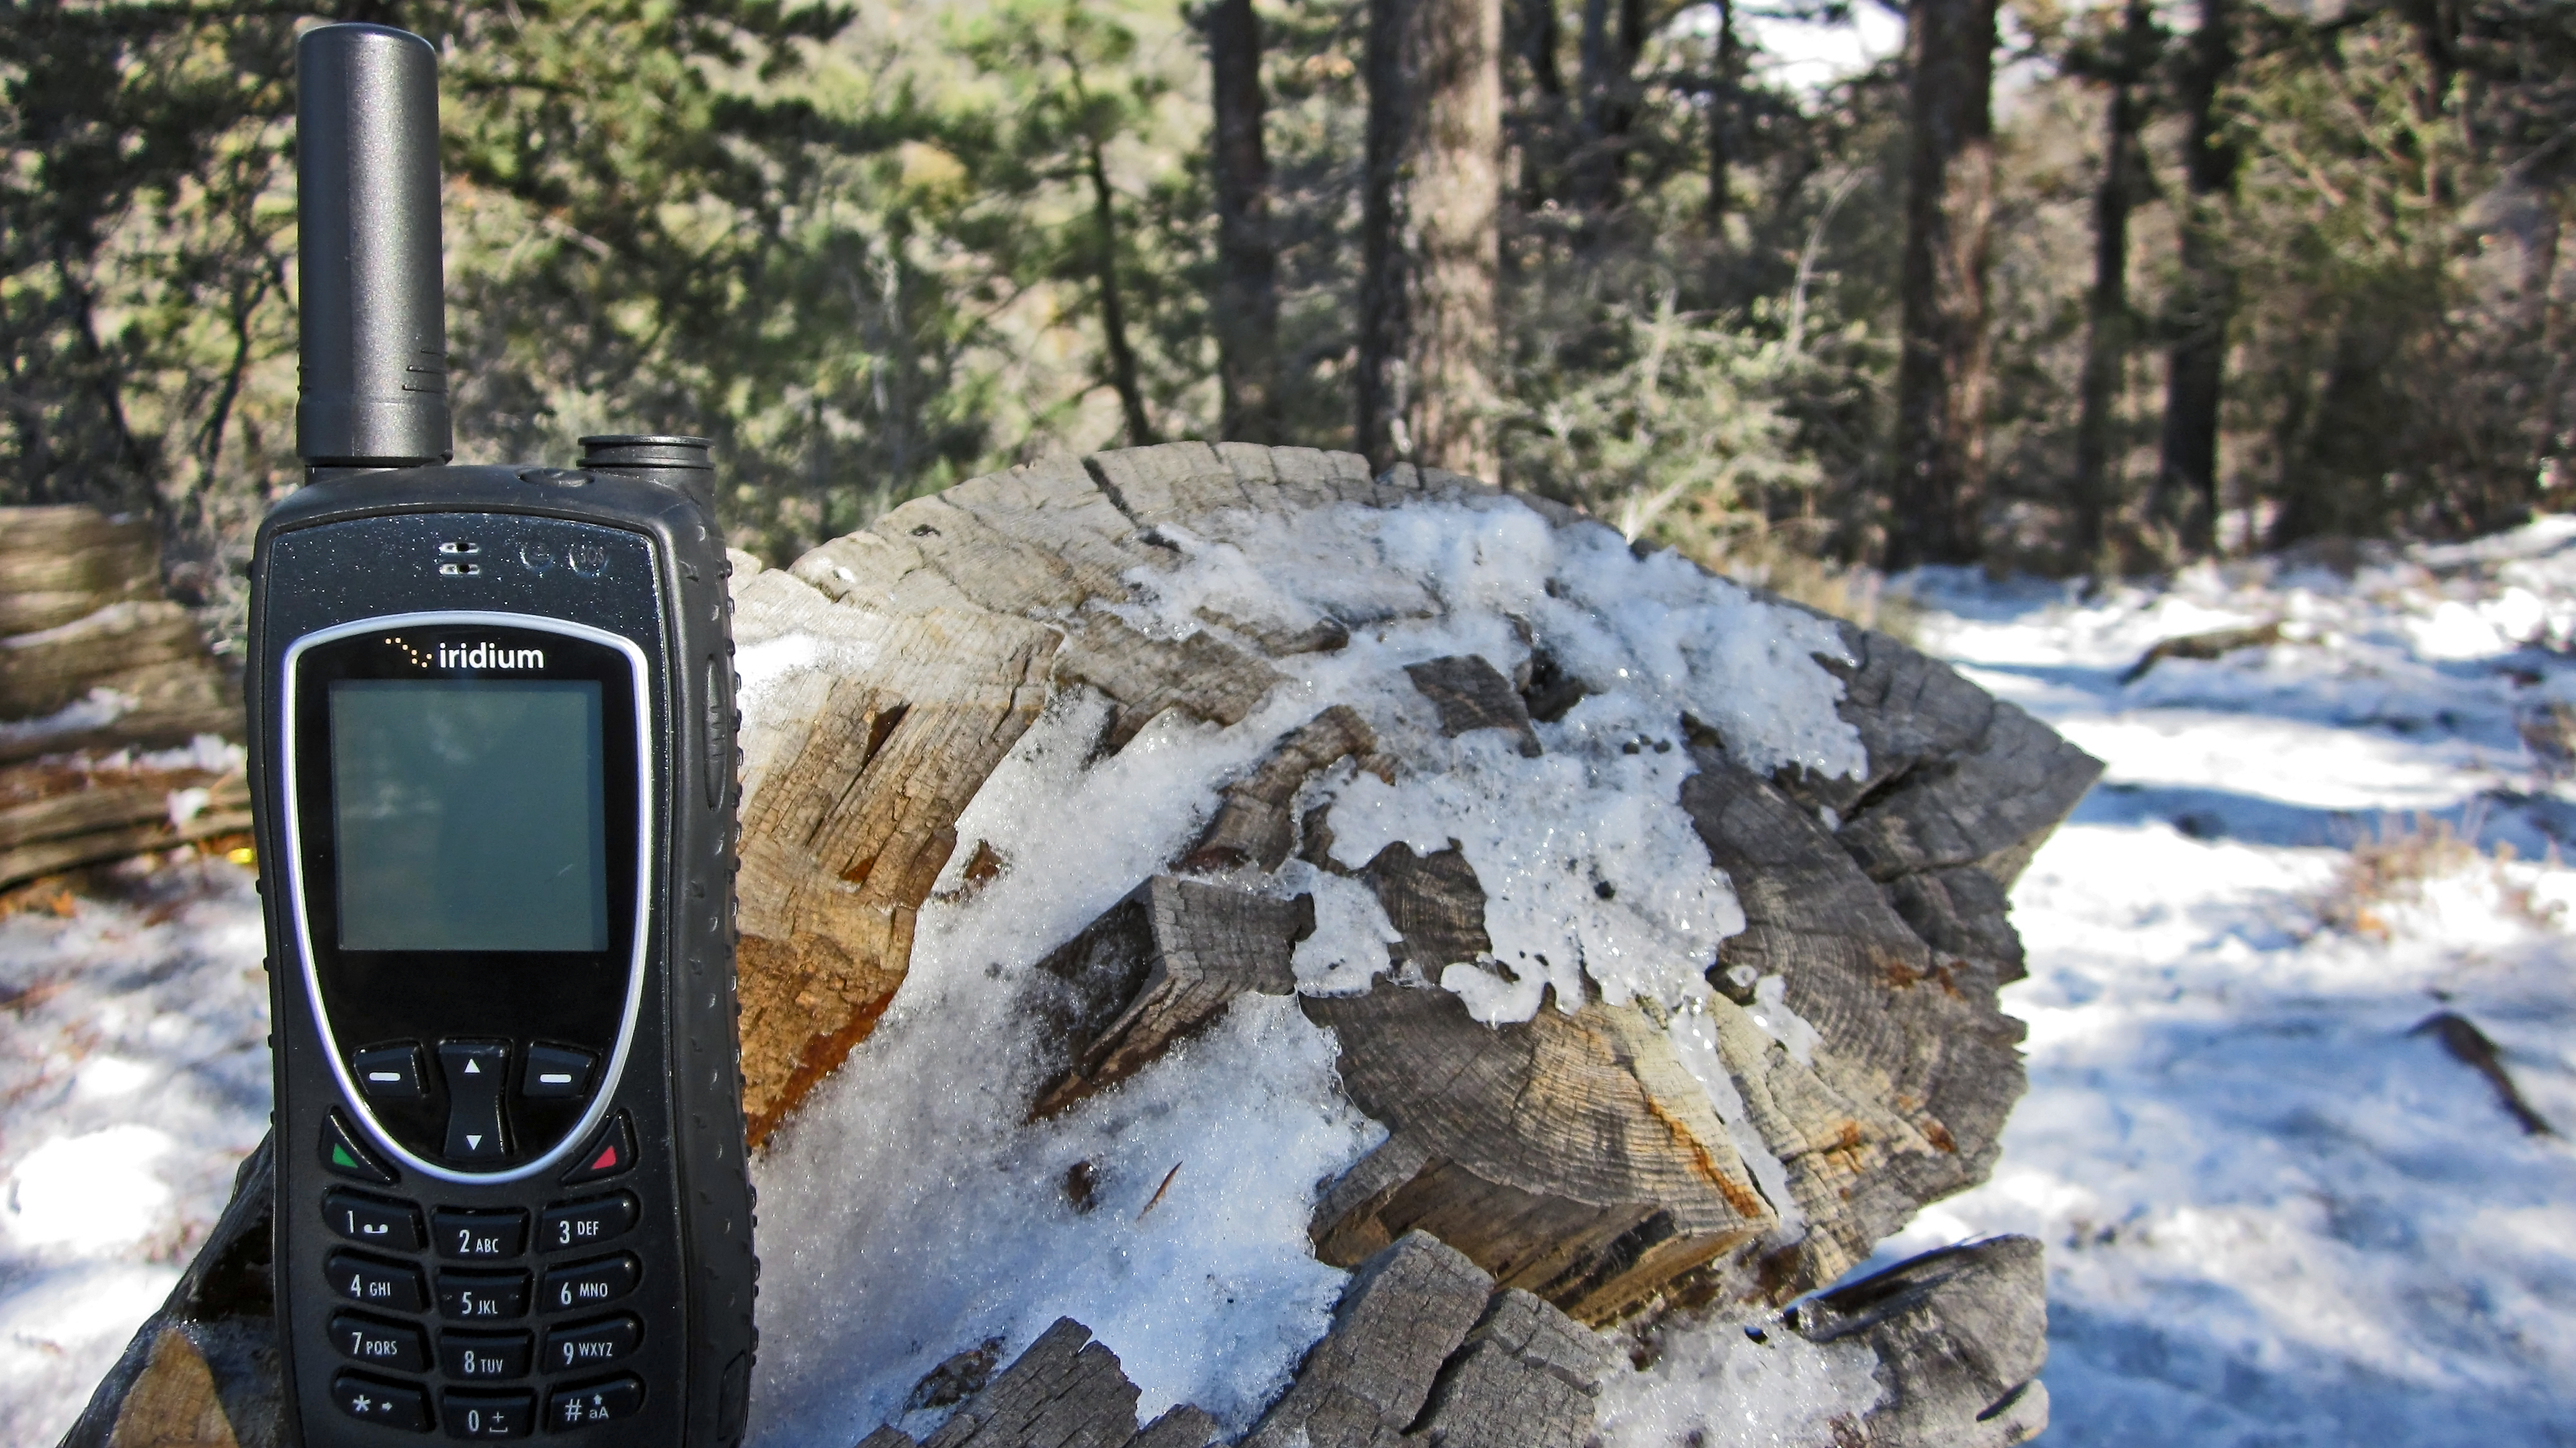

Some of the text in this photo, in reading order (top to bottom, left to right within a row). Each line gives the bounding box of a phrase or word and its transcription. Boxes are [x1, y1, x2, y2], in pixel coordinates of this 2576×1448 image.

[439, 642, 544, 669] iridium
[347, 1210, 354, 1234] 1
[559, 1220, 599, 1244] 3 DEF
[459, 1229, 499, 1253] 2 ABC
[350, 1274, 391, 1297] 4 GHI
[560, 1282, 608, 1305] 6 MNO
[462, 1291, 498, 1315] 5 JKL
[352, 1331, 397, 1355] 7 PQRS
[563, 1342, 612, 1365] 9 WXYZ
[464, 1350, 503, 1373] 8 TUV
[468, 1409, 480, 1432] 0
